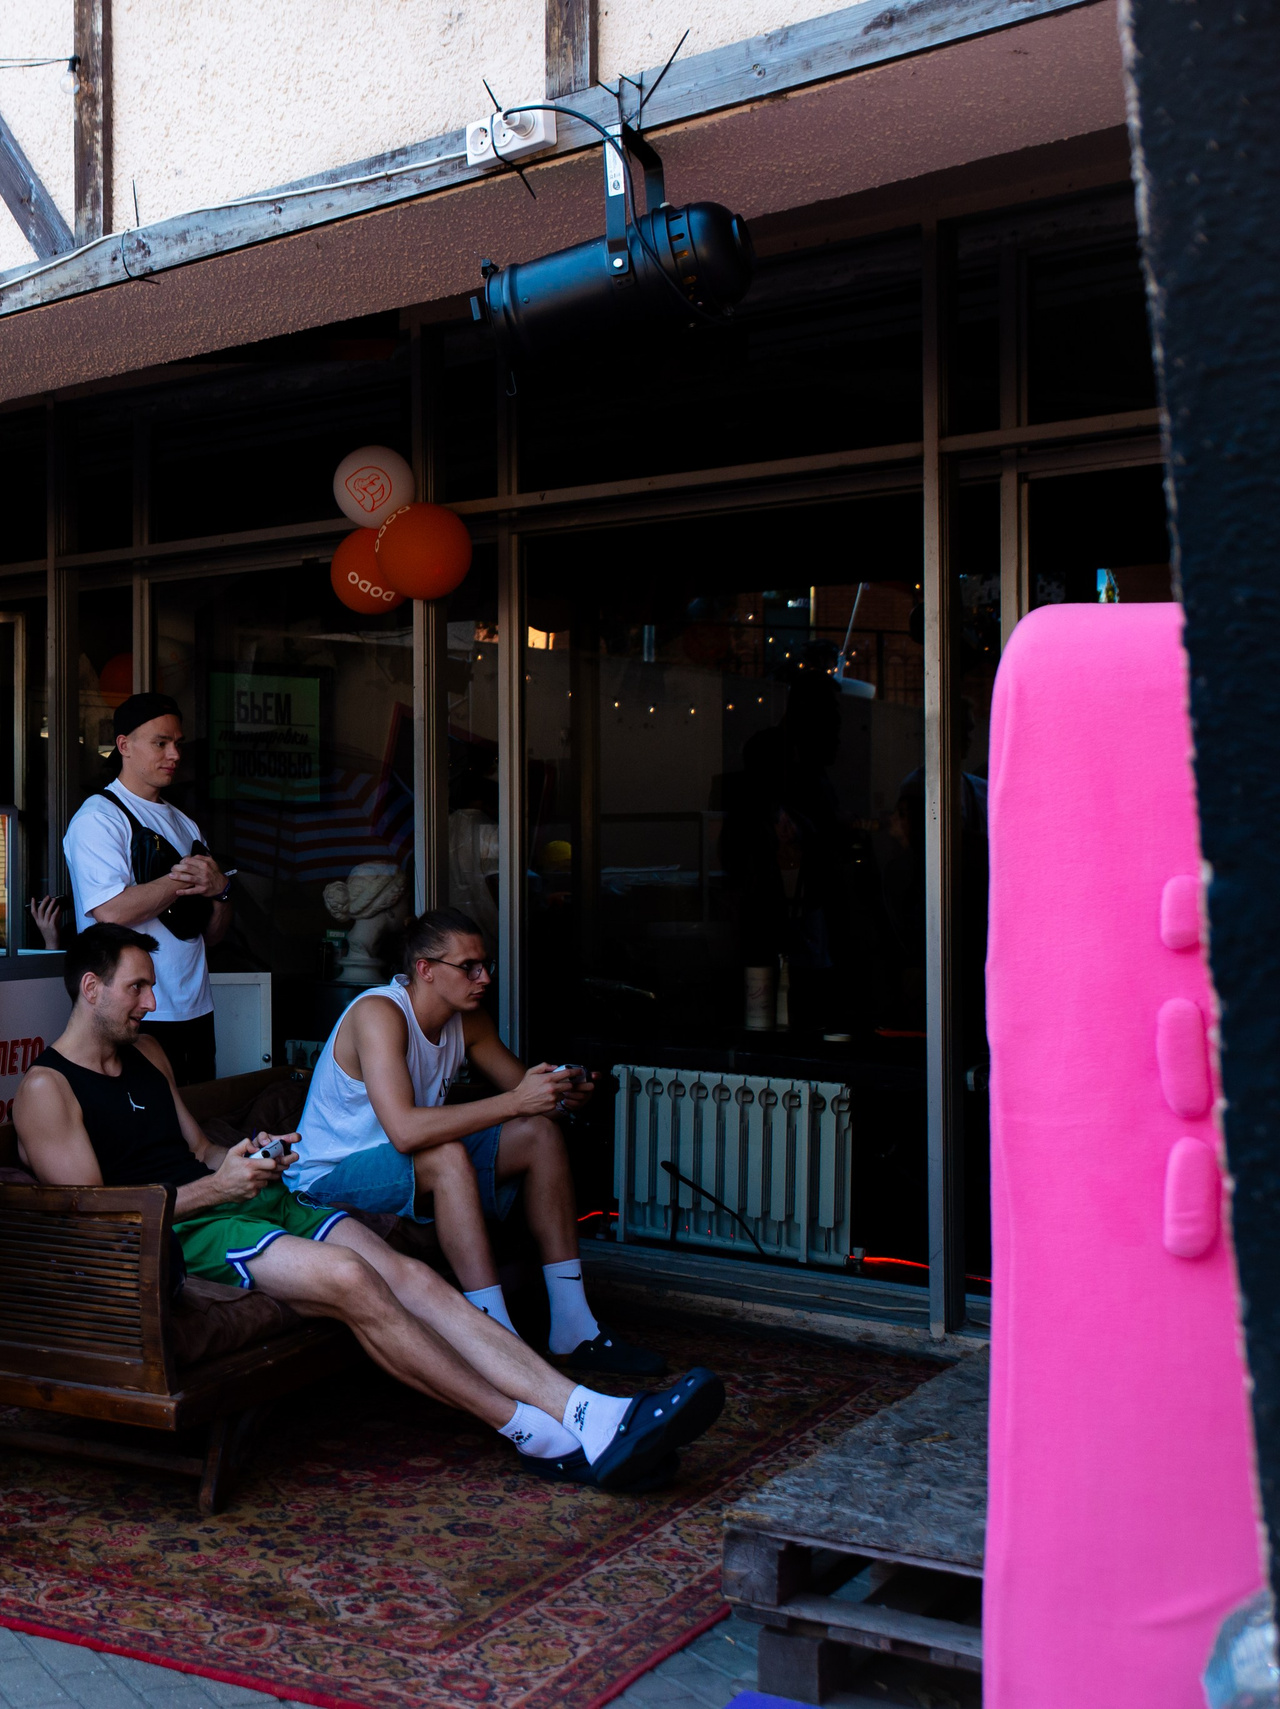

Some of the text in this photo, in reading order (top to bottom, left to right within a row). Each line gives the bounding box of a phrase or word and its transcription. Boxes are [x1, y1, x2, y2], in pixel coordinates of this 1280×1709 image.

[374, 505, 411, 553] DODO
[347, 571, 396, 602] DODO
[236, 690, 291, 725] БЬЕМ
[230, 750, 312, 779] ЛЮБОВЬЮ
